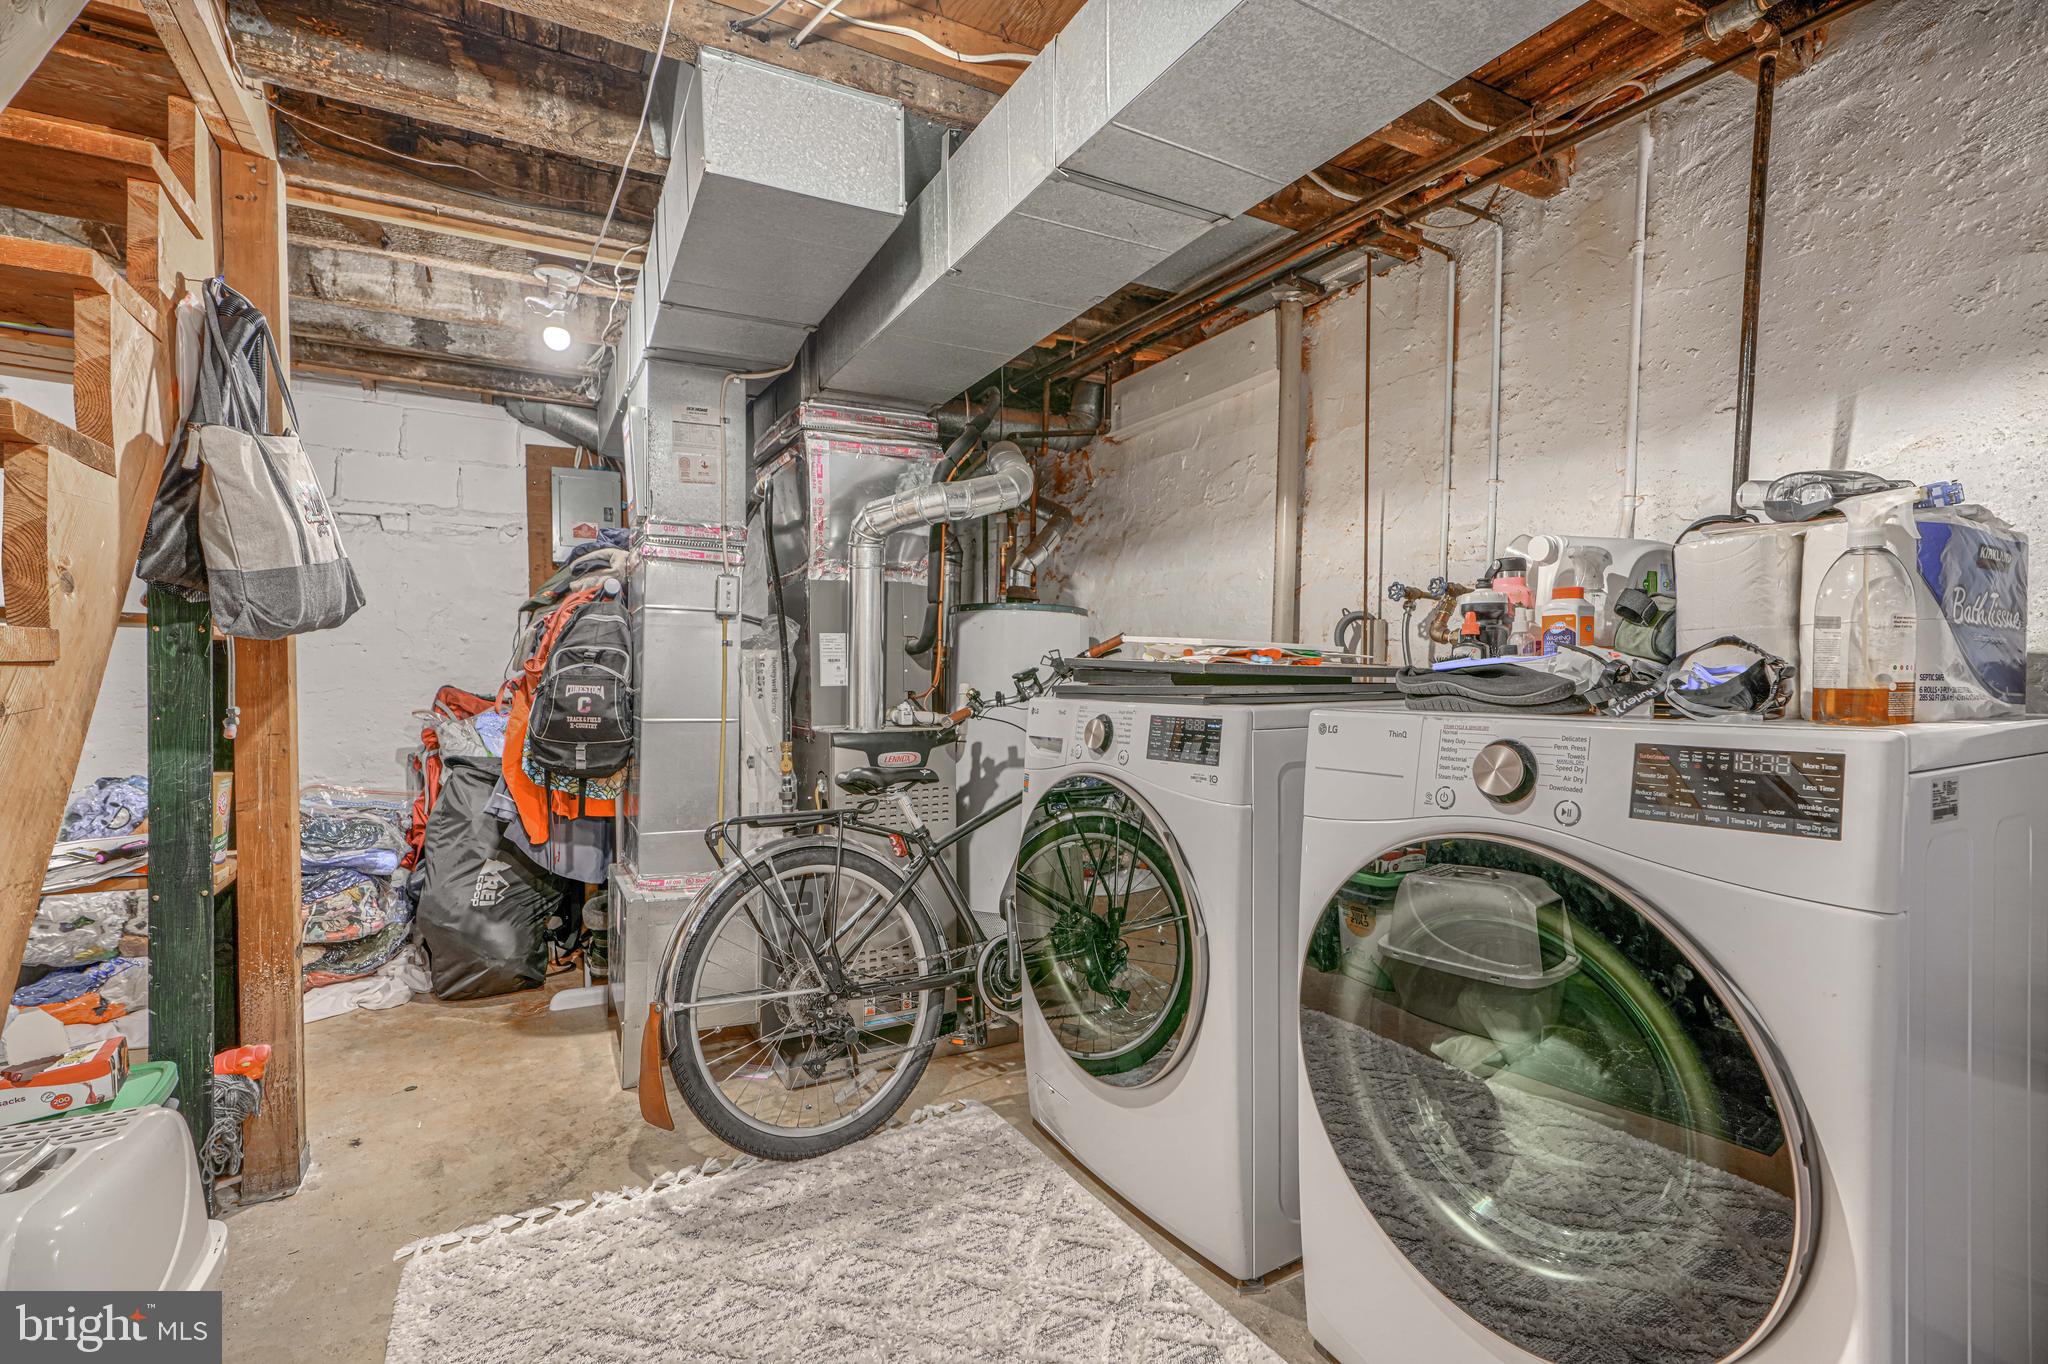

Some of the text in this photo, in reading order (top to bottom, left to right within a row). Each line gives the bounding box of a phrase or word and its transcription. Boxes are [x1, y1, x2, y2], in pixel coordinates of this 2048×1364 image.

[1979, 546, 2012, 564] KIRKLAND
[1952, 586, 2021, 630] Bath Tissue
[1919, 673, 1945, 681] SEPTIC SAFE
[1923, 686, 1938, 694] ROLLS
[1623, 687, 1658, 709] Hurley
[577, 696, 592, 713] C
[1327, 725, 1408, 738] LG ThinQ
[1561, 735, 1588, 743] Delicates
[1440, 746, 1458, 754] Bedding
[884, 754, 911, 763] LENNOX
[1567, 752, 1586, 760] Towels
[1574, 766, 1584, 774] Dry
[1802, 762, 1838, 771] More Time
[1573, 776, 1583, 785] Dry
[1549, 783, 1584, 794] Downloaded
[1802, 783, 1836, 792] Less Time
[1633, 807, 1667, 816] Energy Saver
[1797, 803, 1840, 813] Wrinkle Care
[1669, 811, 1696, 820] Dry Level
[1731, 817, 1758, 827] Time Dry
[1767, 821, 1787, 829] Signal
[1796, 823, 1839, 834] Damp Dry Signal
[480, 875, 499, 906] REI
